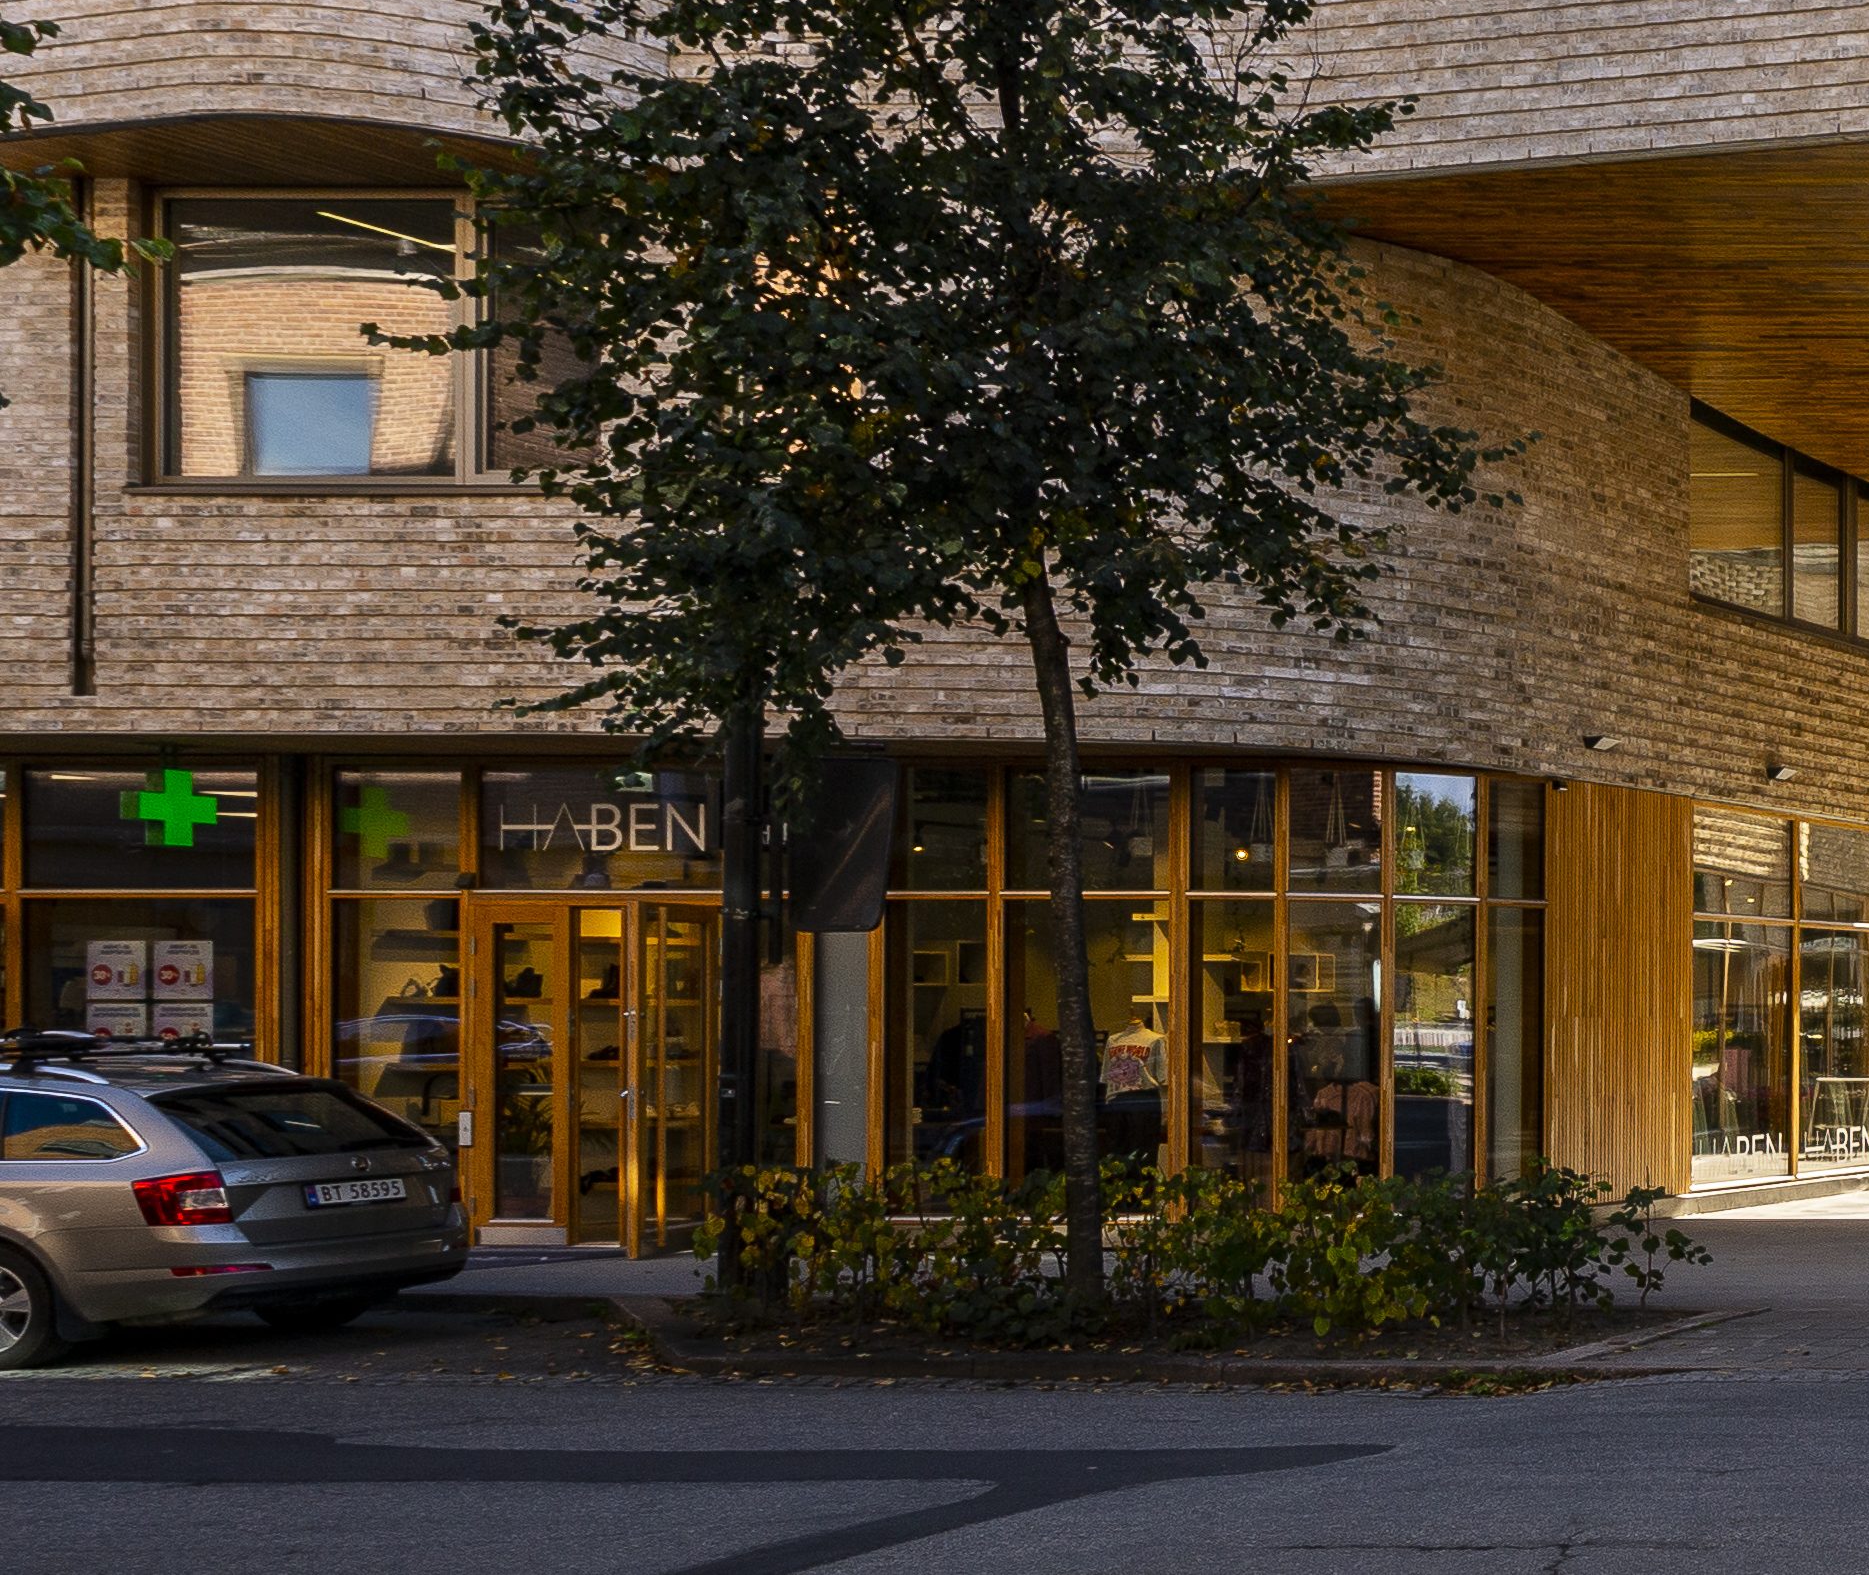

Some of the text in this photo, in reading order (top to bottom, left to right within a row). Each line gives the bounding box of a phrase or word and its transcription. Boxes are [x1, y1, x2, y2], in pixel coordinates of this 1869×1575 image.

[500, 802, 706, 852] HABEN
[320, 1182, 401, 1201] BT 58595
